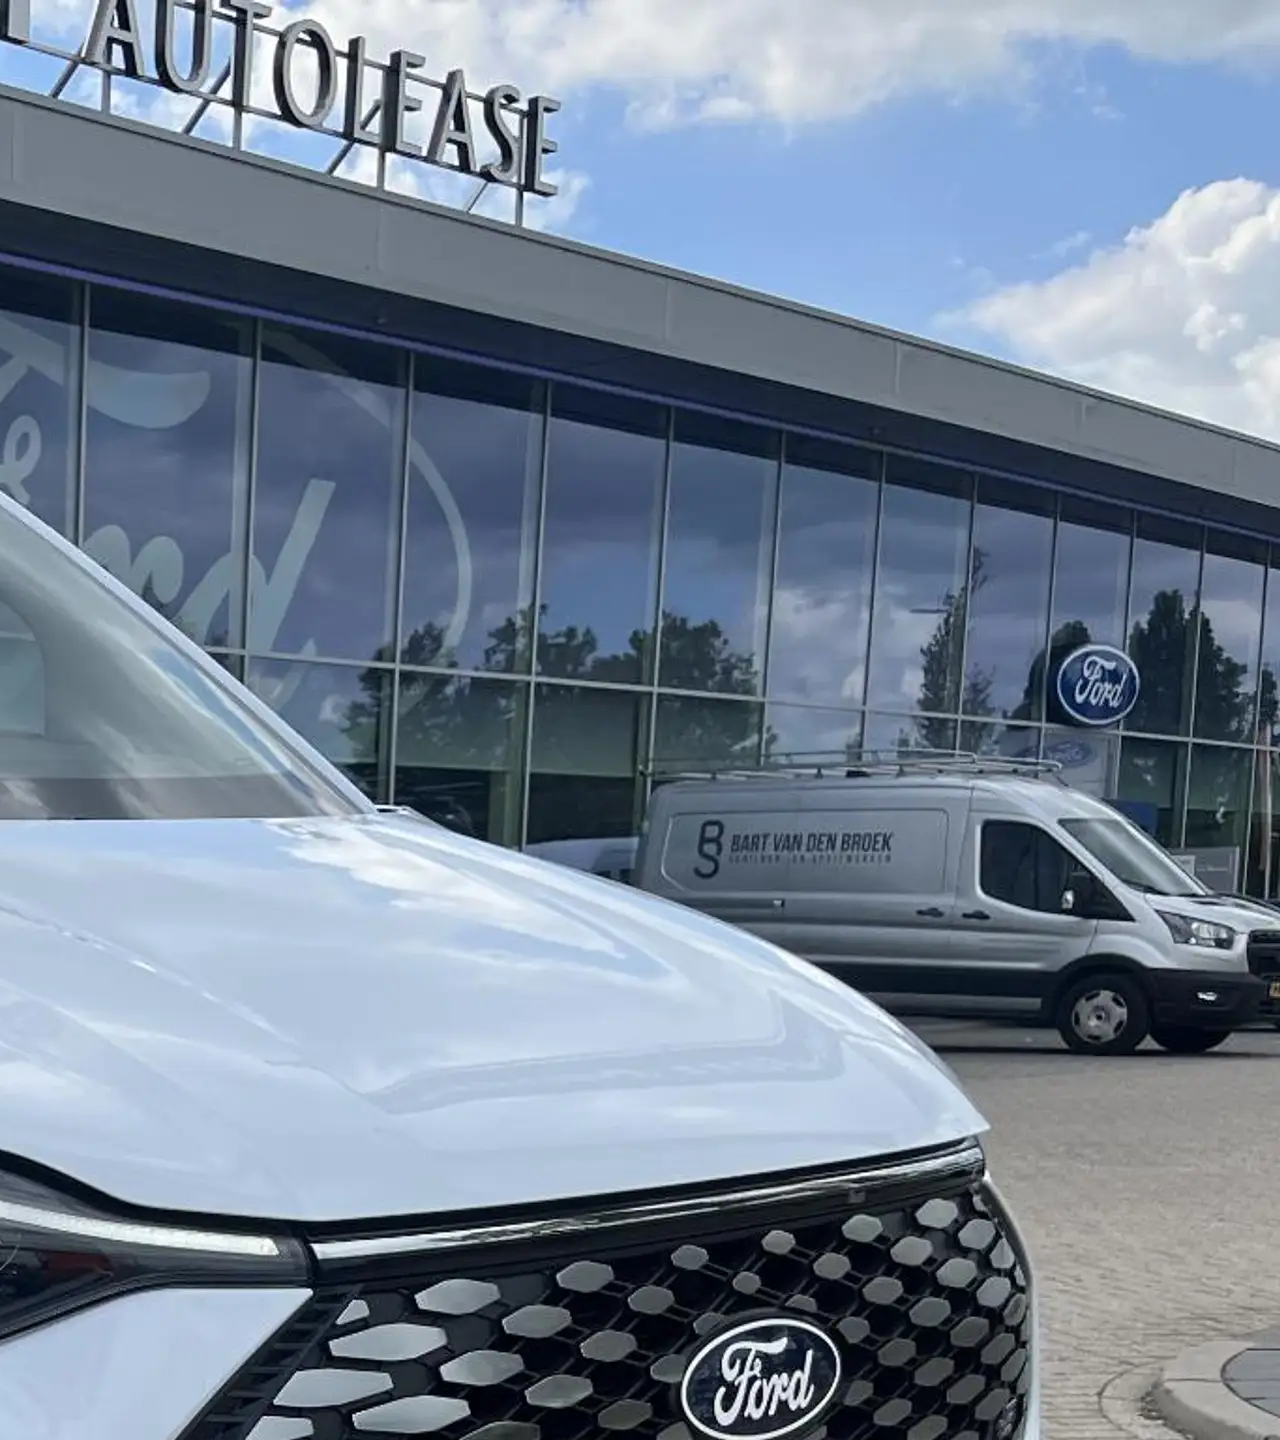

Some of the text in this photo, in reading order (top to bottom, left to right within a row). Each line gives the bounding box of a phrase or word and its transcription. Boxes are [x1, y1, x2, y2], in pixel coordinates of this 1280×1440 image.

[83, 0, 562, 197] AUTOLEASE
[1075, 655, 1129, 708] Ford
[730, 832, 894, 852] BART VAN DEN BROEK
[714, 1336, 815, 1427] Ford
